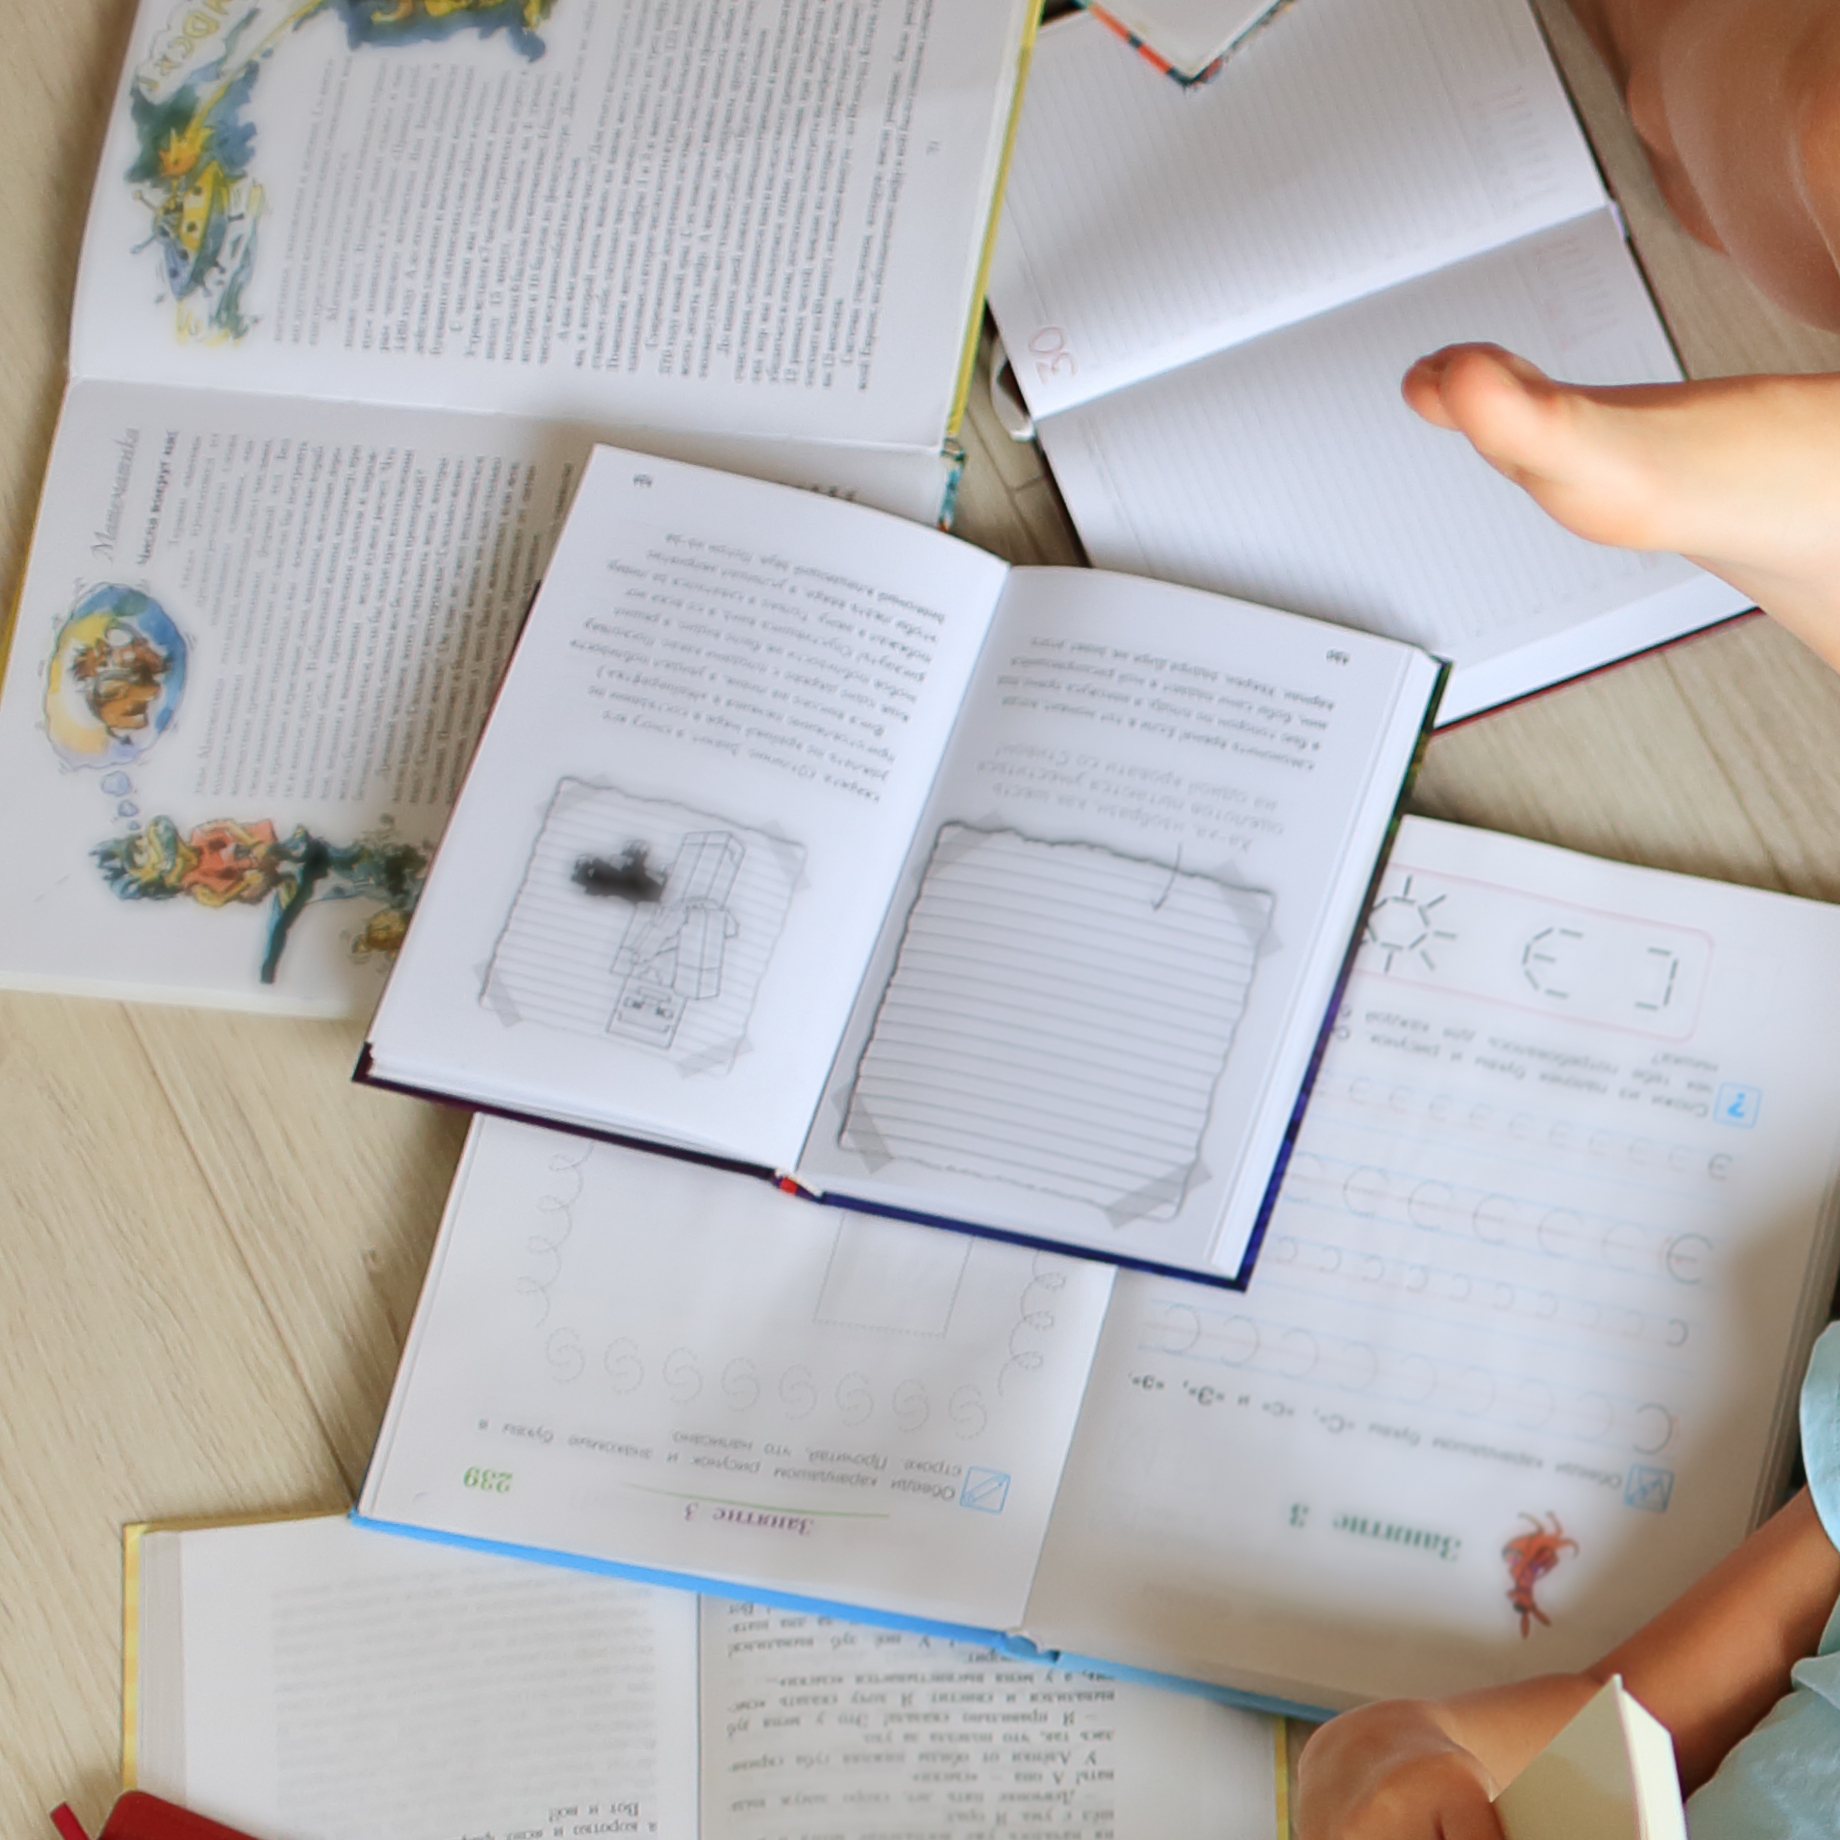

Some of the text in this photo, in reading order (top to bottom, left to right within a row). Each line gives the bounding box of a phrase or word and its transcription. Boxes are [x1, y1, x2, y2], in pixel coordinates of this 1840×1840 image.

[463, 1466, 515, 1494] 239
[683, 1501, 814, 1537] Занятие 3
[1288, 1501, 1461, 1563] Занятие 3
